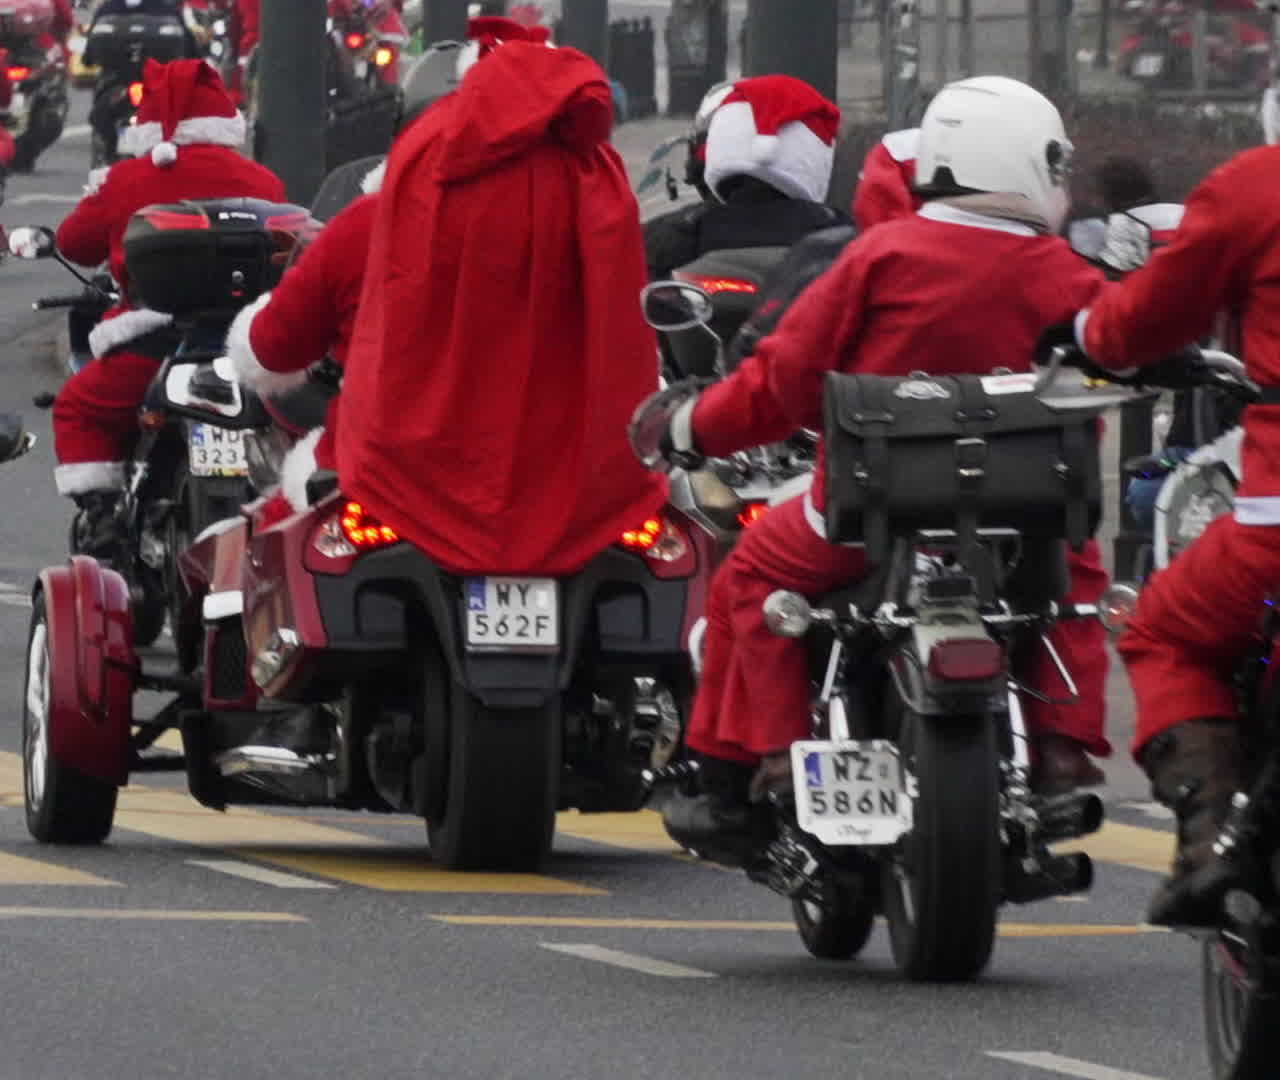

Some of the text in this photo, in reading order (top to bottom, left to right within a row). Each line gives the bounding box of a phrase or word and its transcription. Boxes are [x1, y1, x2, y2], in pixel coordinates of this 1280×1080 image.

[495, 583, 531, 608] WY
[475, 614, 550, 638] 562F
[810, 788, 898, 816] 586N
